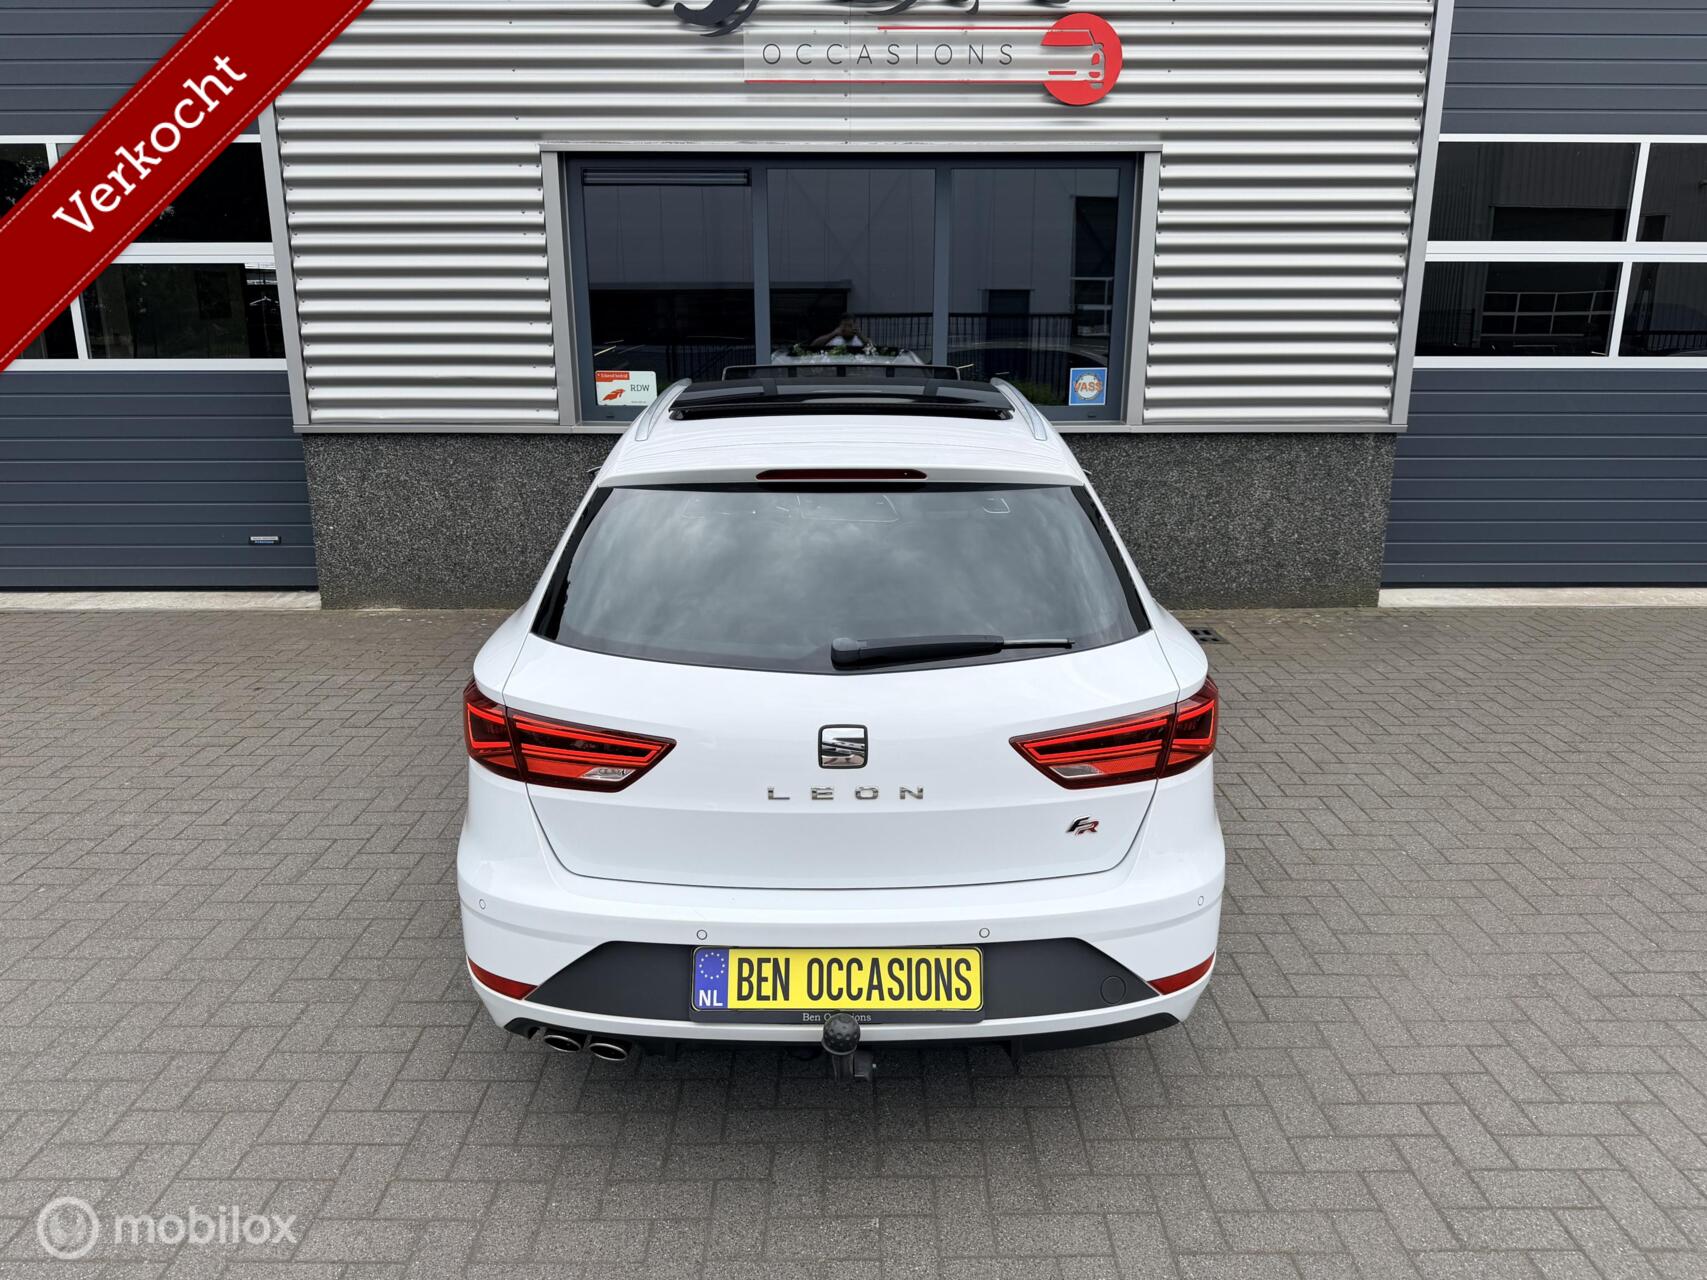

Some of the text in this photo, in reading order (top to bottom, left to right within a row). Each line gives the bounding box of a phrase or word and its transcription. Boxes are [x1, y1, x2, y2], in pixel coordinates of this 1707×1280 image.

[761, 43, 1014, 66] OCCASIONS
[630, 384, 650, 392] RDW
[767, 785, 924, 801] LEON
[1066, 815, 1100, 836] FR
[736, 957, 973, 1002] BEN OCCASIONS
[699, 989, 723, 1007] NL
[802, 1012, 872, 1022] Ben Oions
